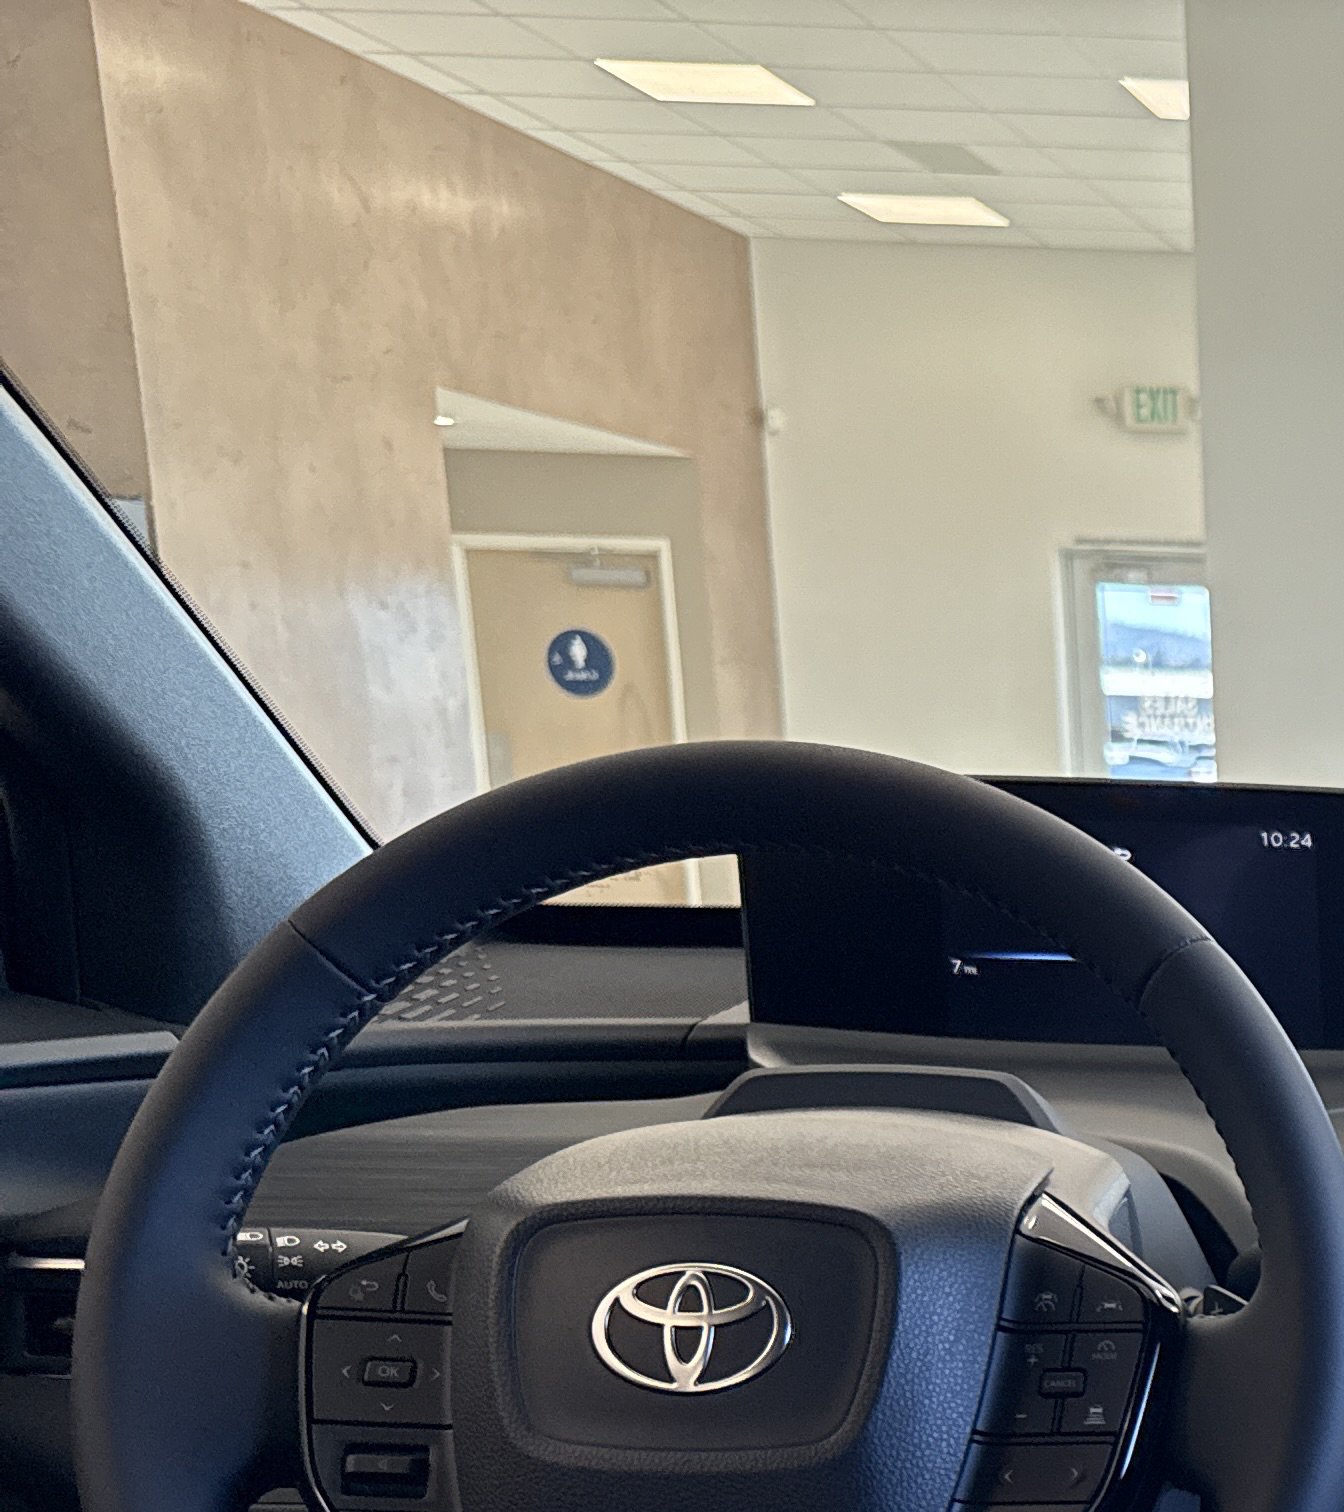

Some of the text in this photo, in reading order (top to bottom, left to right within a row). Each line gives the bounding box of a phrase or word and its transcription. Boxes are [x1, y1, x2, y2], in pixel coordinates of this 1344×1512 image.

[1134, 386, 1177, 423] EXIT
[1260, 831, 1312, 848] 10:24
[951, 959, 961, 974] 7
[277, 1280, 308, 1289] AUTO
[378, 1366, 398, 1377] OK
